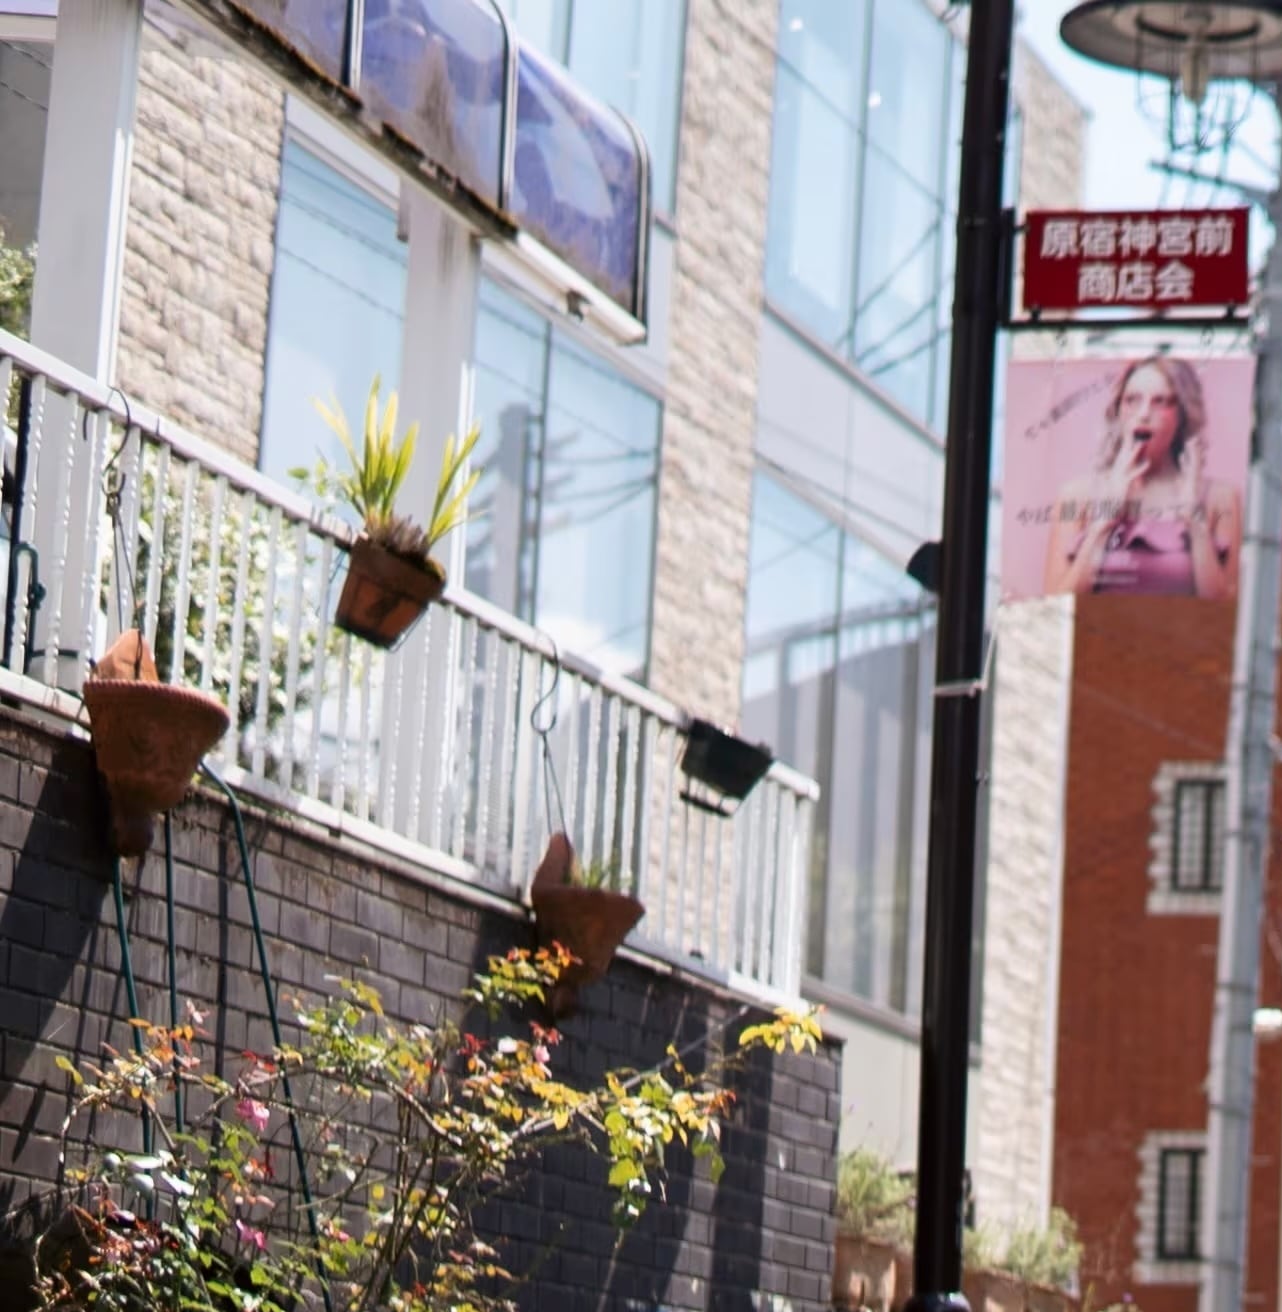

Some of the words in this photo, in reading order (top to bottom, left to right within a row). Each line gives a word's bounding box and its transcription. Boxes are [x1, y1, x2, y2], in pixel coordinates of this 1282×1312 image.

[1040, 216, 1235, 260] 原宿神宮前
[1077, 260, 1195, 303] 商店会
